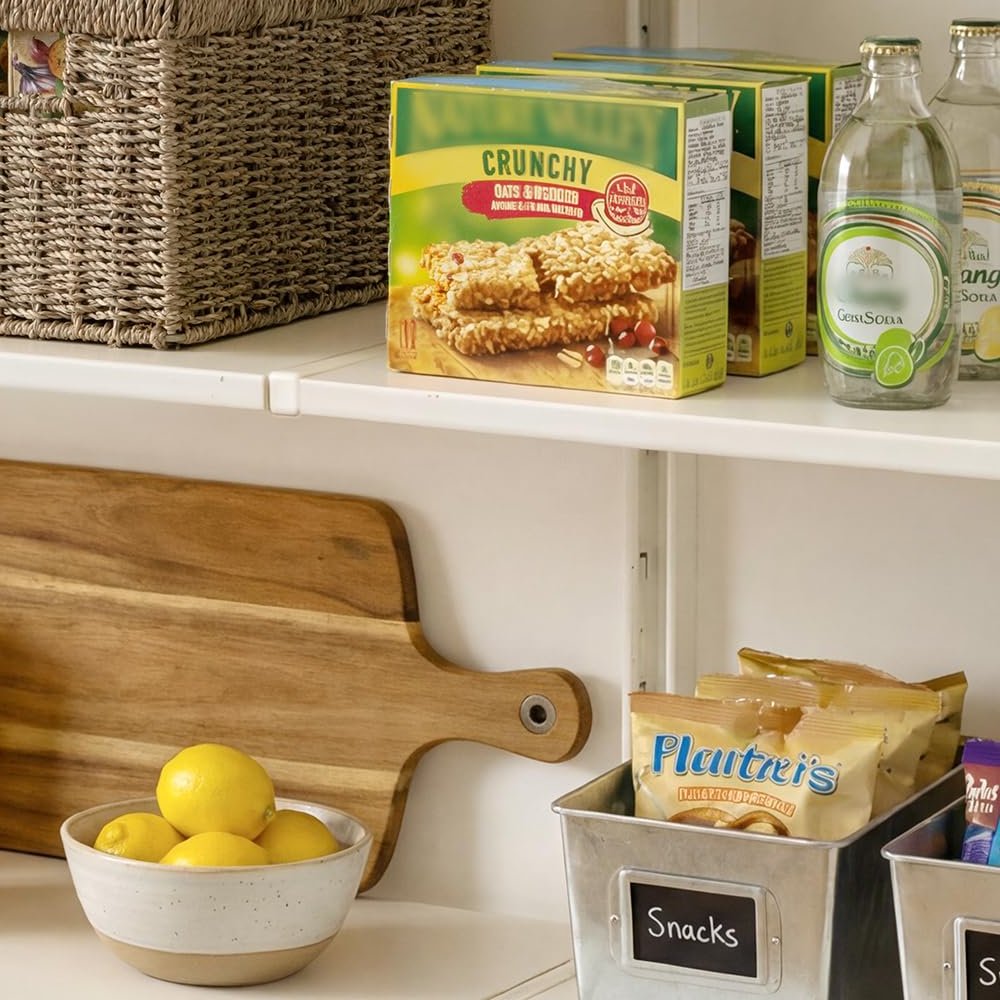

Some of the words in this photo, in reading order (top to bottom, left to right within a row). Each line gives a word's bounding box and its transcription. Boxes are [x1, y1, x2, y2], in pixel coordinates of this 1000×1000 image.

[482, 148, 593, 185] CRUNCHY
[494, 183, 520, 199] OATS
[647, 906, 739, 948] Snacks
[979, 956, 1000, 986] S
